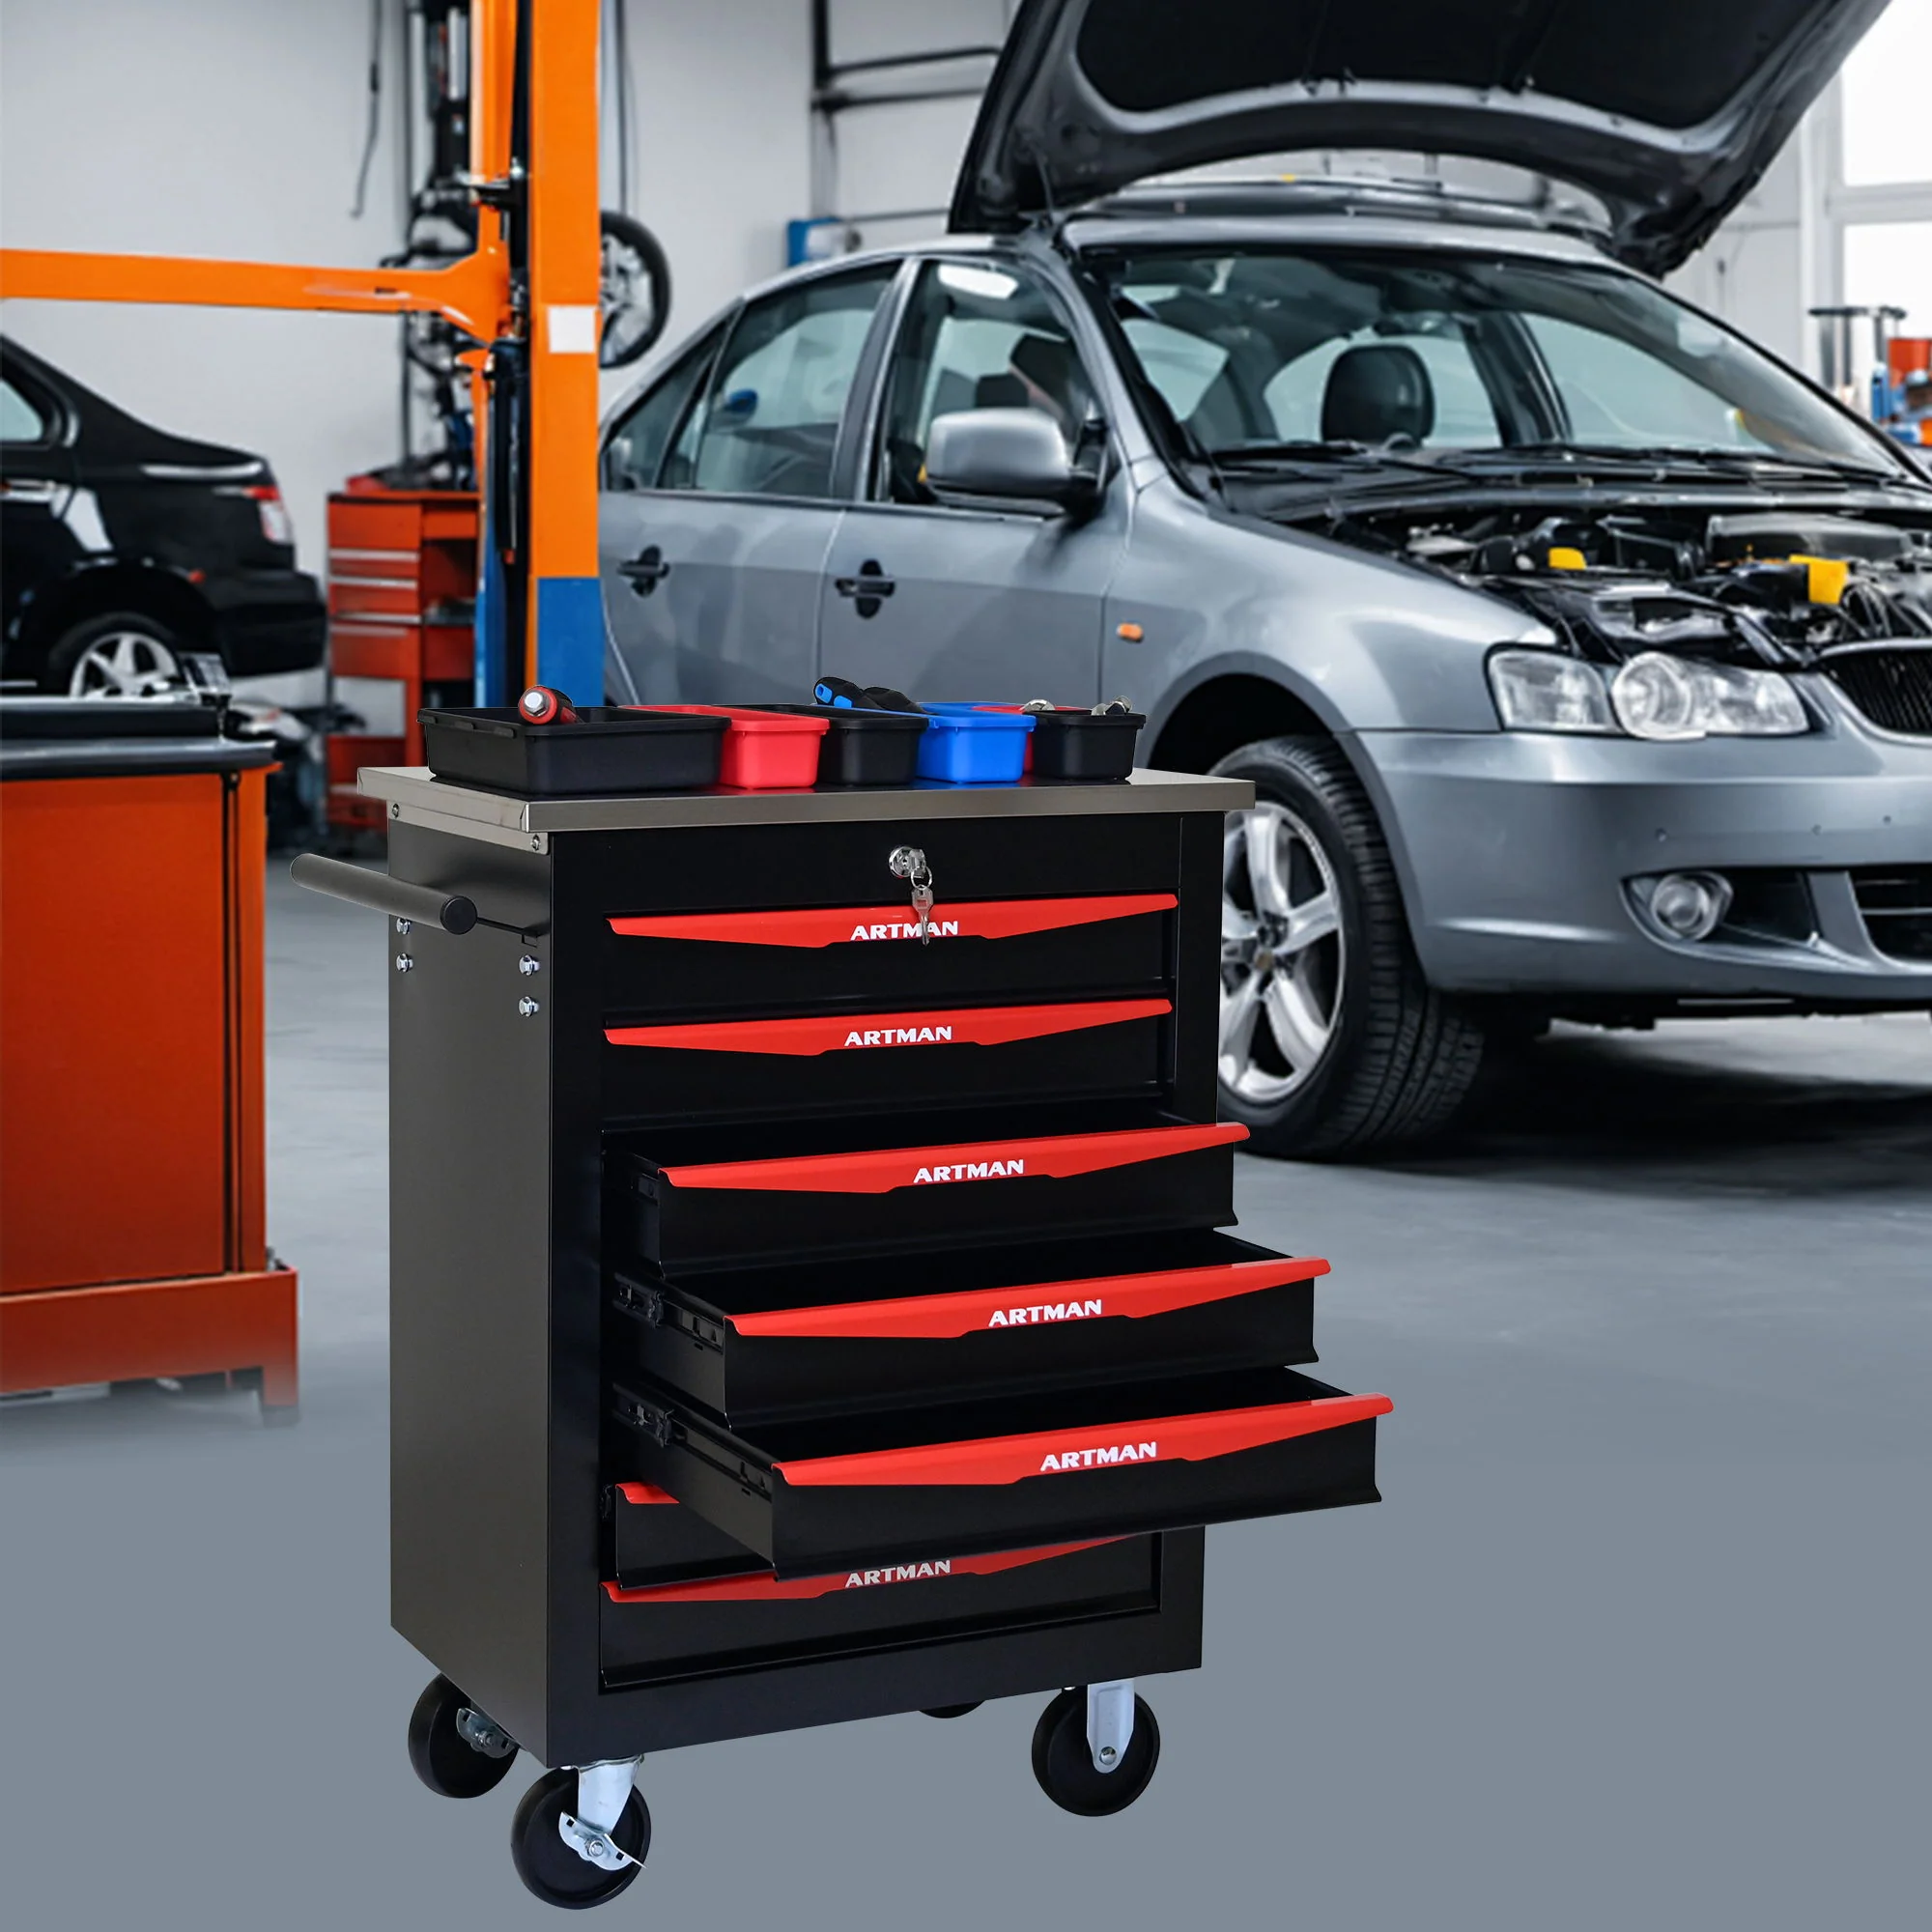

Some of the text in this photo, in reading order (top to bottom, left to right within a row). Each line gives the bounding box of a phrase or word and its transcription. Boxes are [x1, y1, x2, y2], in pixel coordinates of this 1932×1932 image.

[850, 921, 958, 940] ARTMAN
[843, 1025, 952, 1046] ARTMAN
[913, 1158, 1024, 1183] ARTMAN
[988, 1298, 1102, 1327] ARTMAN
[1039, 1441, 1157, 1471] ARTMAN
[844, 1559, 951, 1587] ARTMAN
